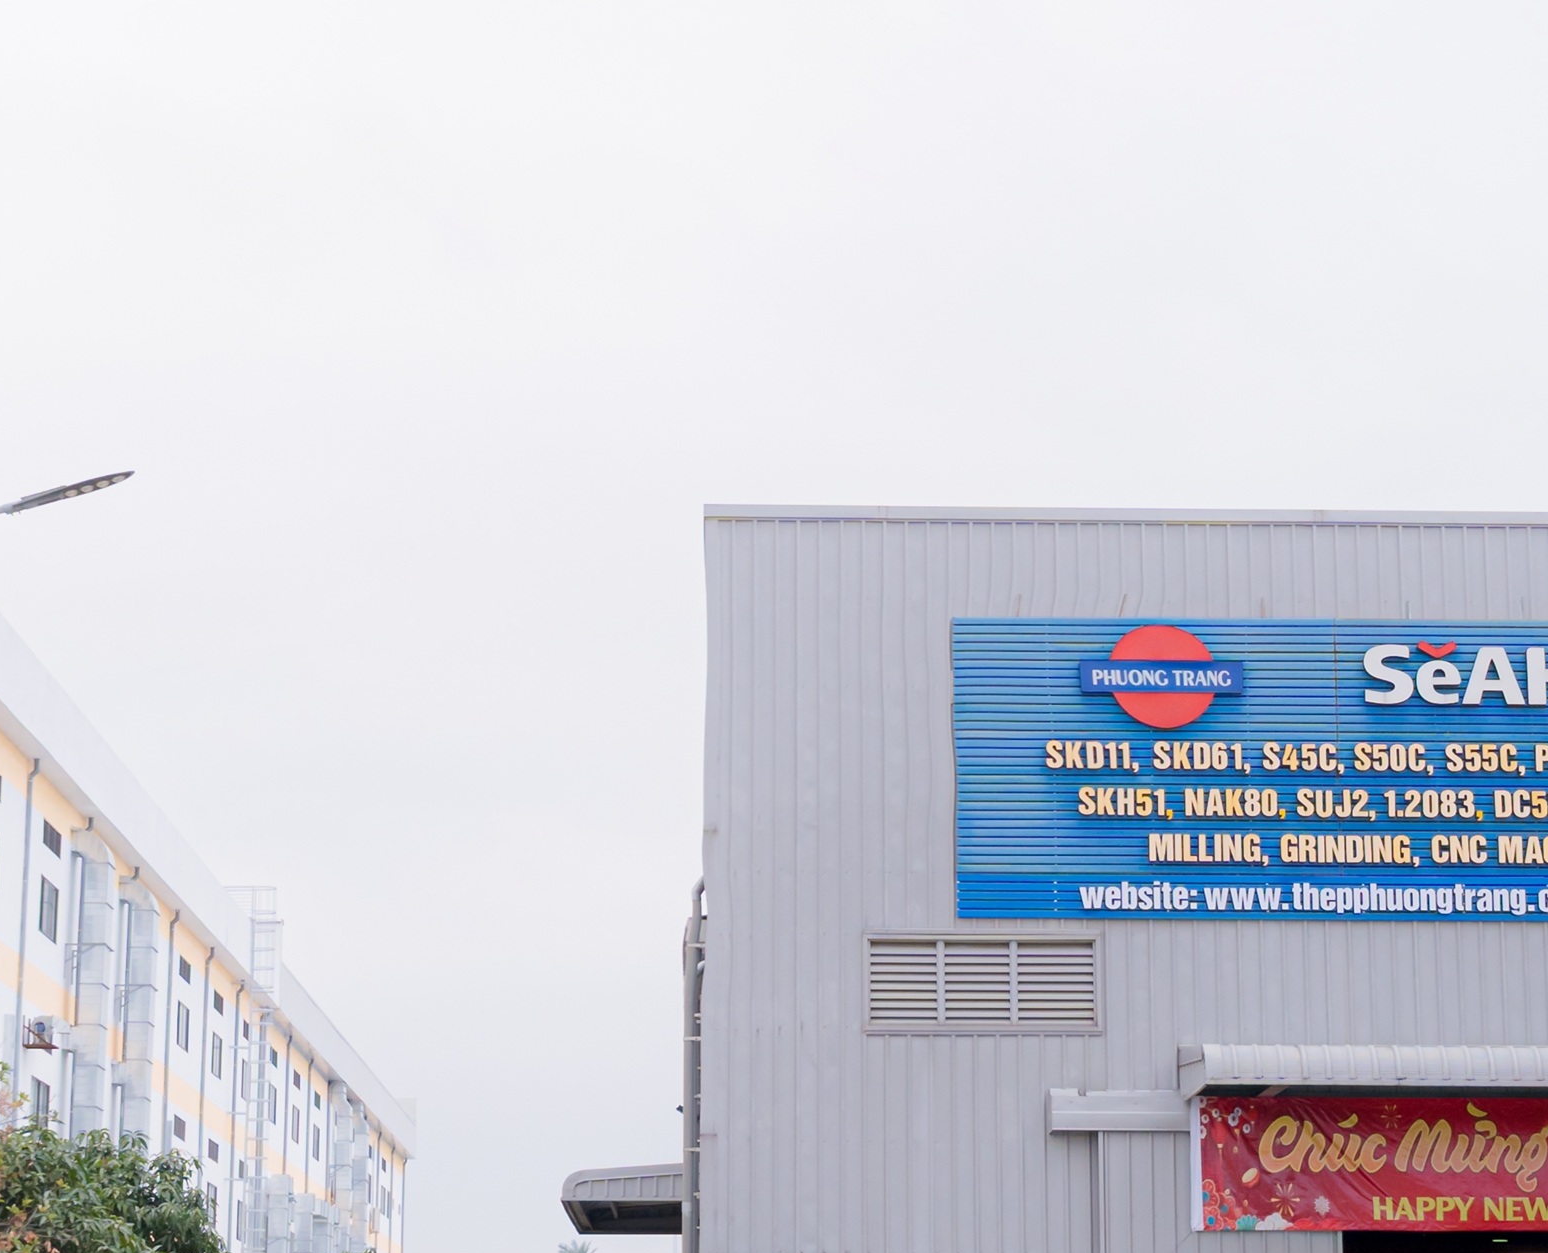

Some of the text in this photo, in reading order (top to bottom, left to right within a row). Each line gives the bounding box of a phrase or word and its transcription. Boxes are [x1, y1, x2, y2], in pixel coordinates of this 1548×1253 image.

[1092, 669, 1233, 688] PHUONG TRANG
[1045, 741, 1140, 774] SKD11,
[1153, 742, 1251, 775] SKD61,
[1263, 743, 1345, 775] S45C,
[1354, 742, 1434, 775] S50C,
[1445, 743, 1526, 776] S55C,
[1078, 786, 1173, 821] SKH51,
[1184, 788, 1287, 820] NAK80,
[1296, 788, 1377, 821] SUJ2,
[1384, 789, 1484, 821] 1.2083,
[1148, 833, 1269, 866] MILLING,
[1280, 834, 1420, 867] GRINDING,
[1430, 835, 1488, 865] CNC
[1079, 881, 1198, 911] website:
[1257, 1114, 1388, 1174] Chúc
[1372, 1196, 1476, 1222] HAPPY
